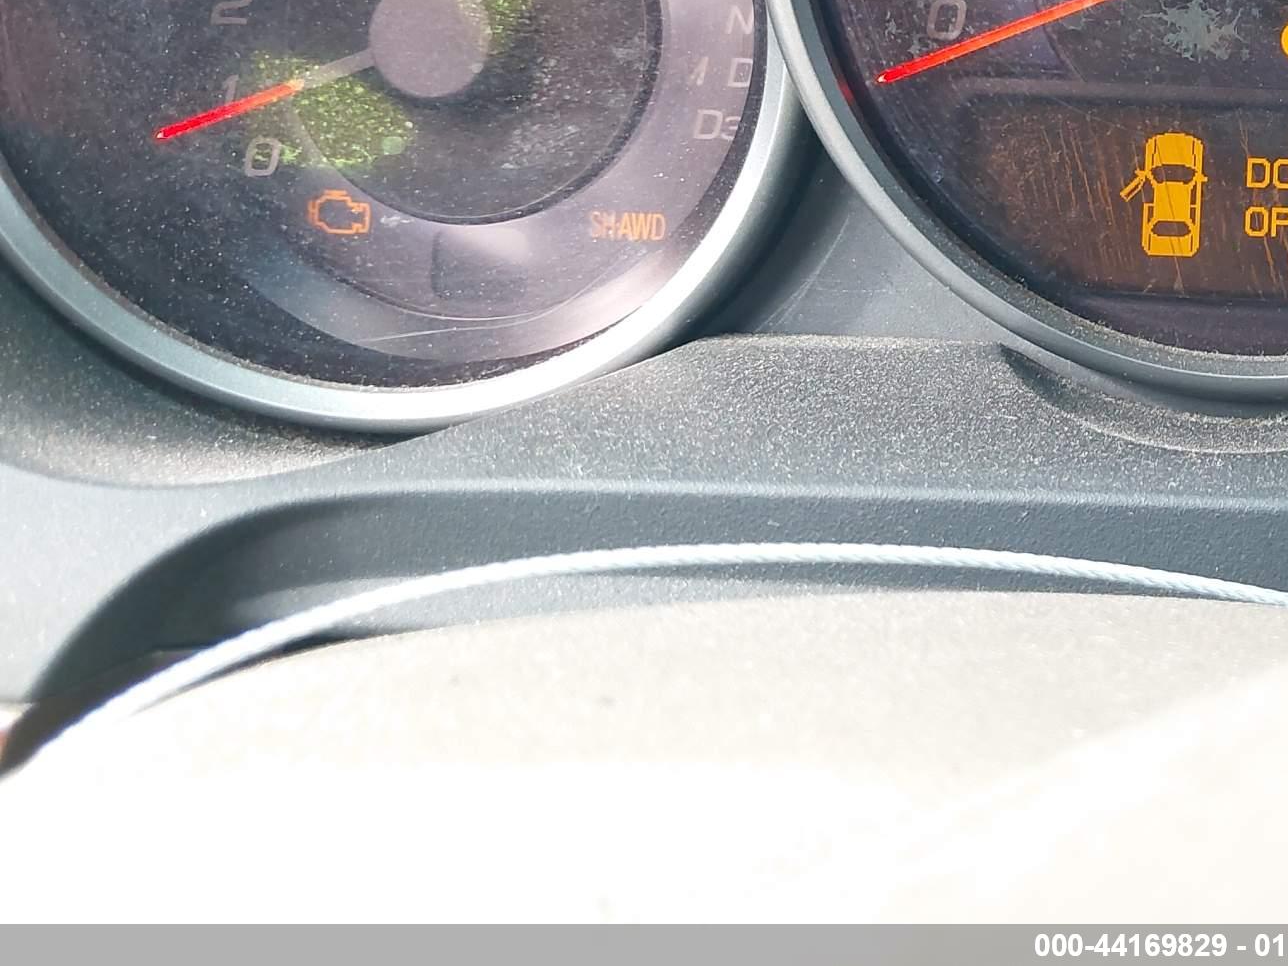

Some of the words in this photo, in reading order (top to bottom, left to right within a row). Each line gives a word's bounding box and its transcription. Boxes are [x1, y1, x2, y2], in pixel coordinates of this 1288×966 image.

[727, 4, 754, 35] N
[728, 57, 754, 87] D
[244, 137, 282, 178] 0
